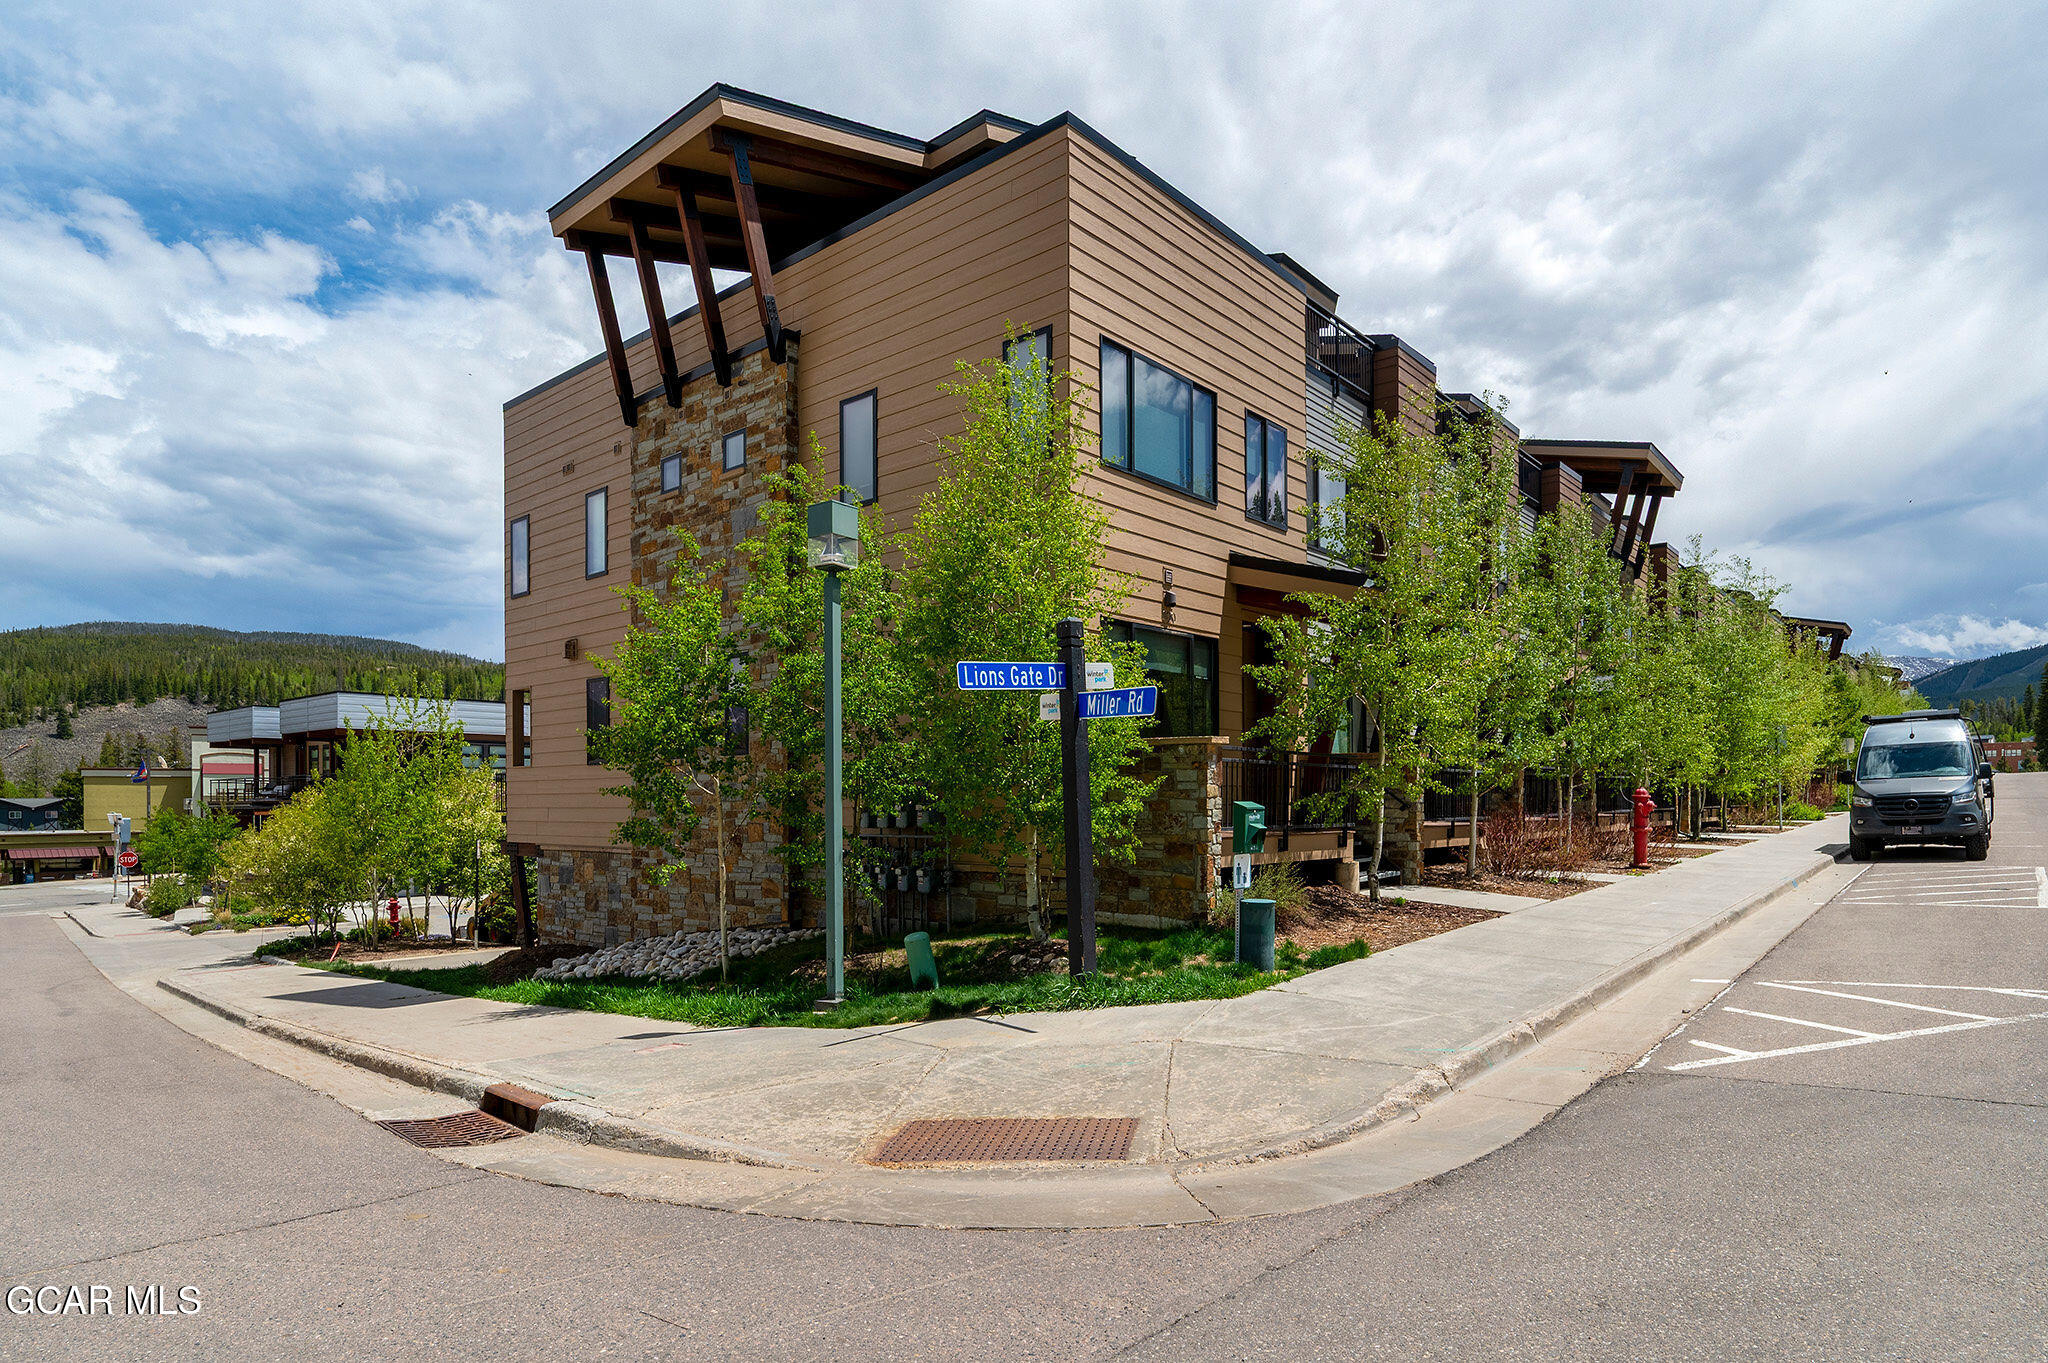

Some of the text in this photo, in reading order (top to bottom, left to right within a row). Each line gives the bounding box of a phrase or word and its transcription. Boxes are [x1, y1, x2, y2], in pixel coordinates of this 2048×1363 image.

[963, 665, 1063, 686] Lions Gate Dr
[1087, 690, 1144, 716] Miller Rd
